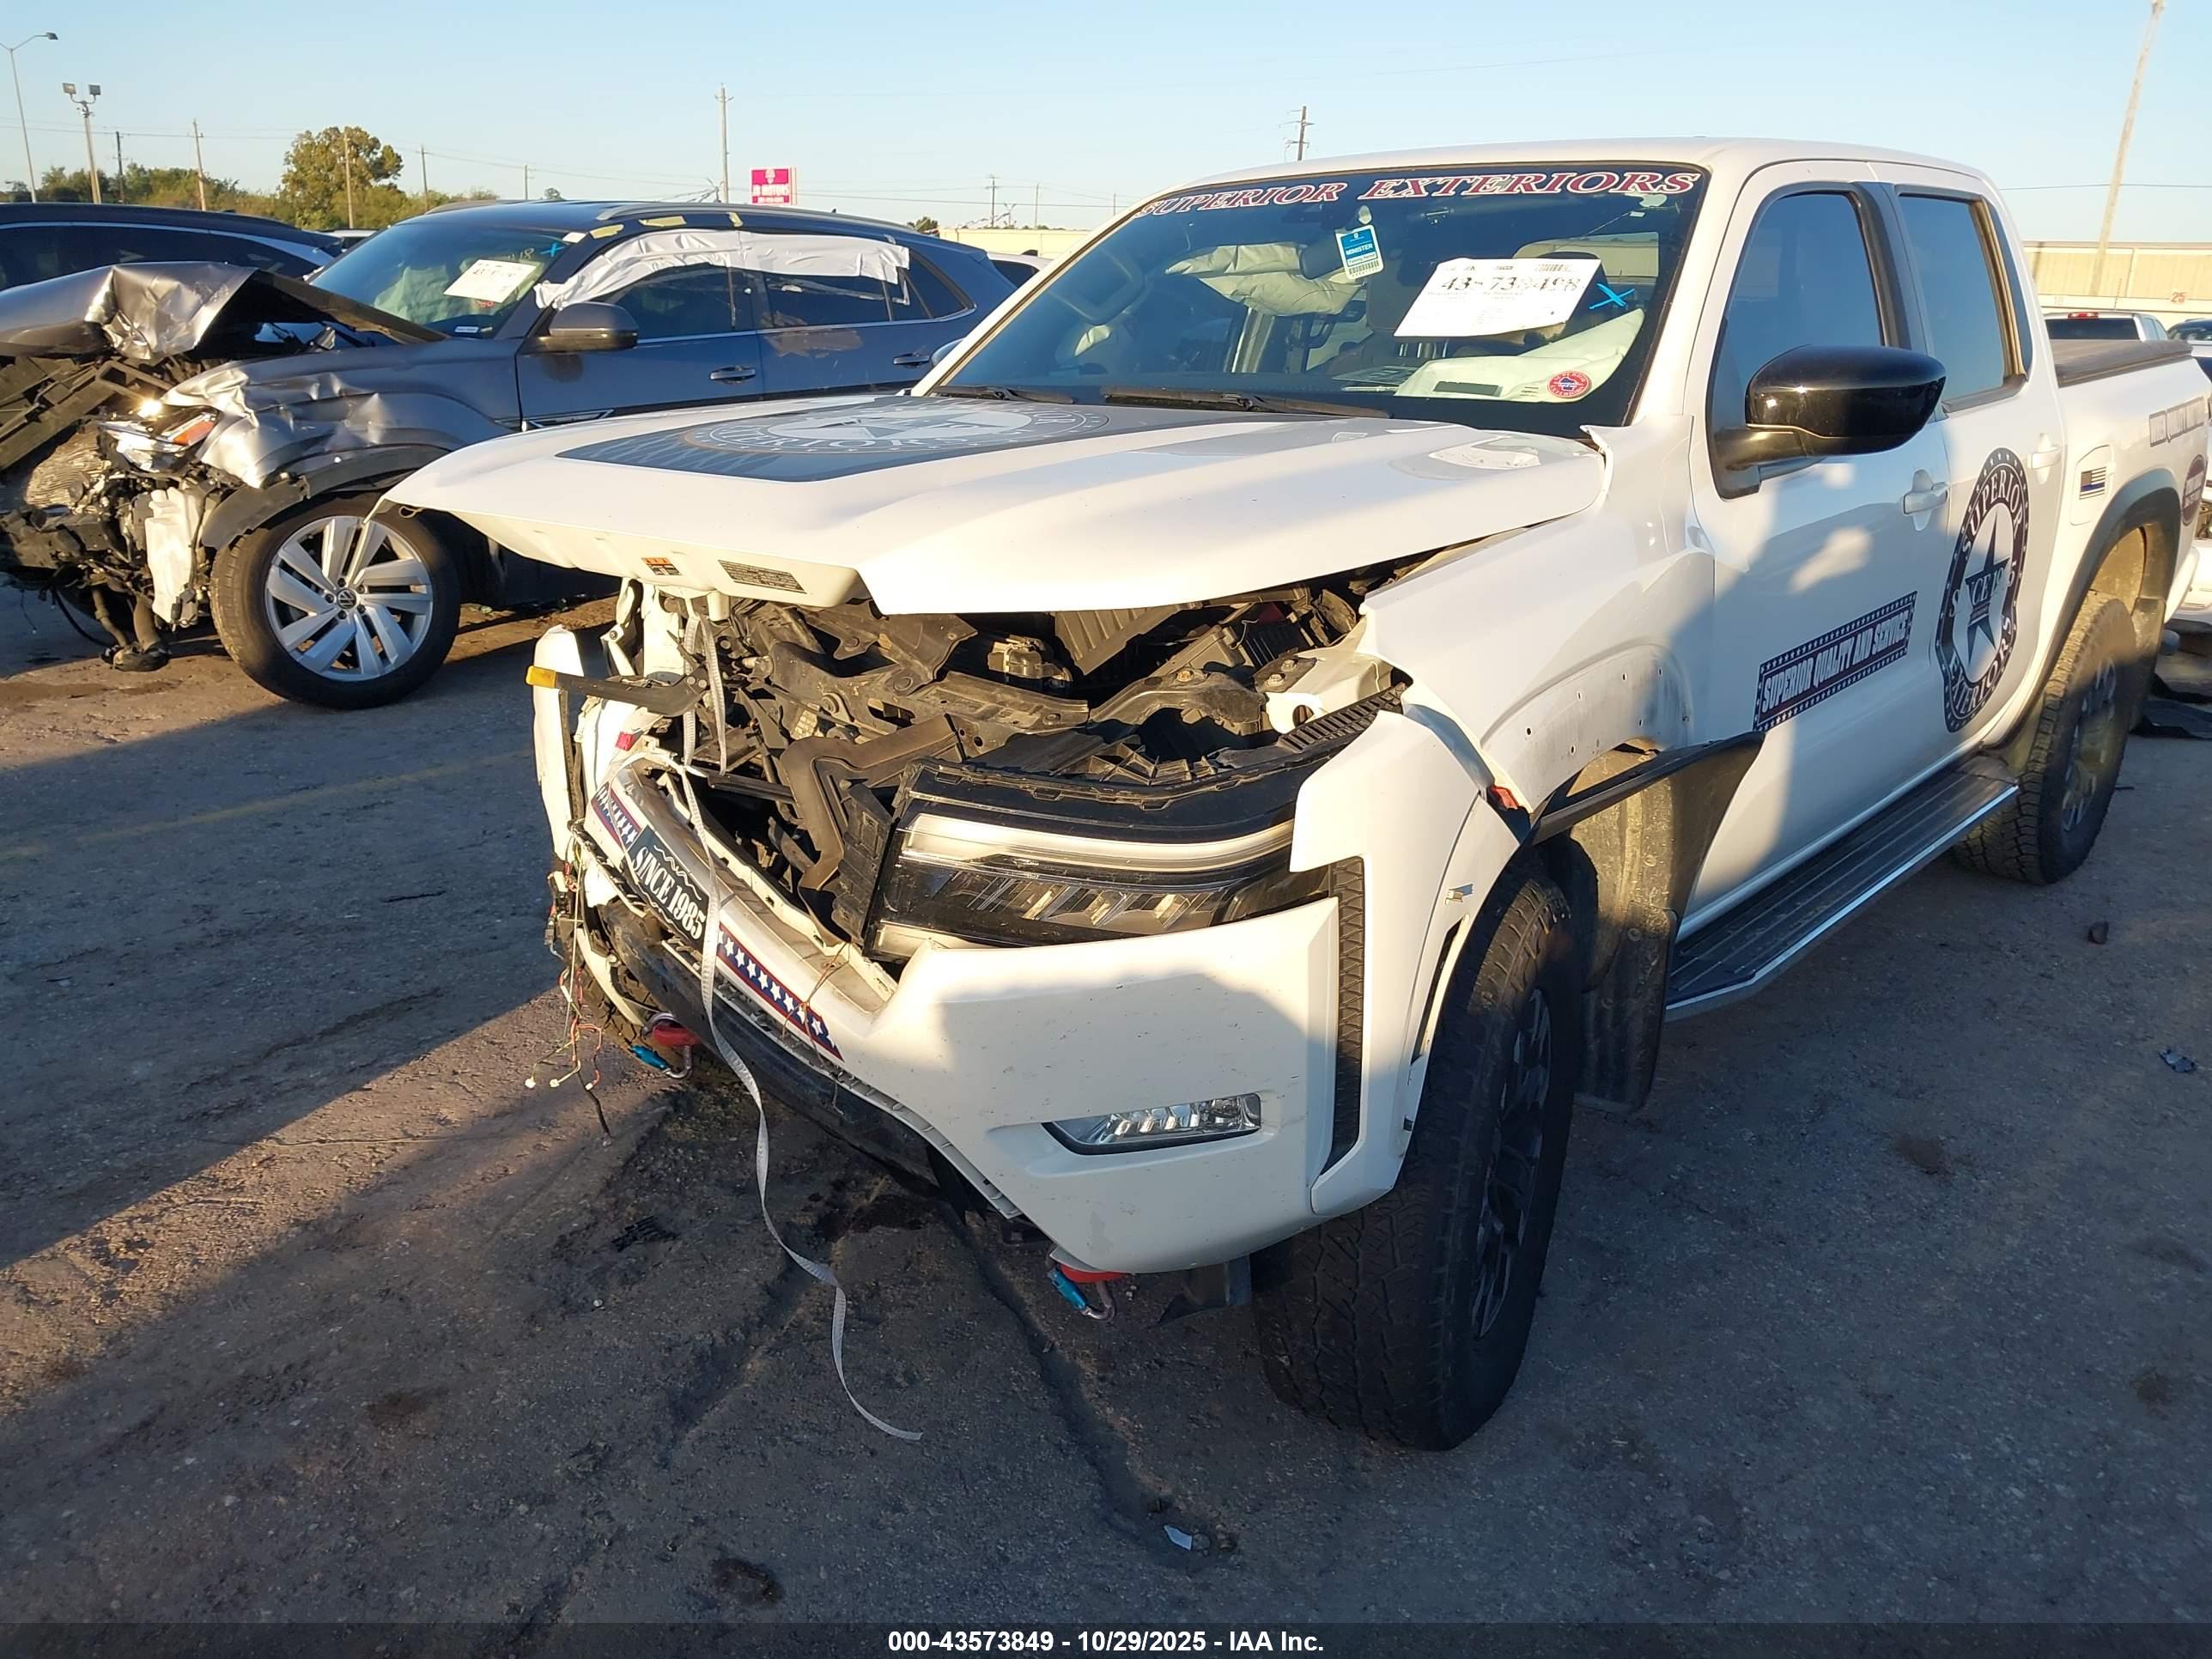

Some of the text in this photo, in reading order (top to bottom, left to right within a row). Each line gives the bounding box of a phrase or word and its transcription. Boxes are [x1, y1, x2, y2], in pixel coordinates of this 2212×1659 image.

[1133, 172, 1702, 219] SUPERIOR EXTERIORS
[1962, 469, 2024, 560] SUPERIOR
[1762, 610, 1910, 713] SUPERIOR QUALITY AND SERVICE
[1949, 615, 2012, 714] EXTERIORS
[632, 847, 707, 940] SINCE 1985
